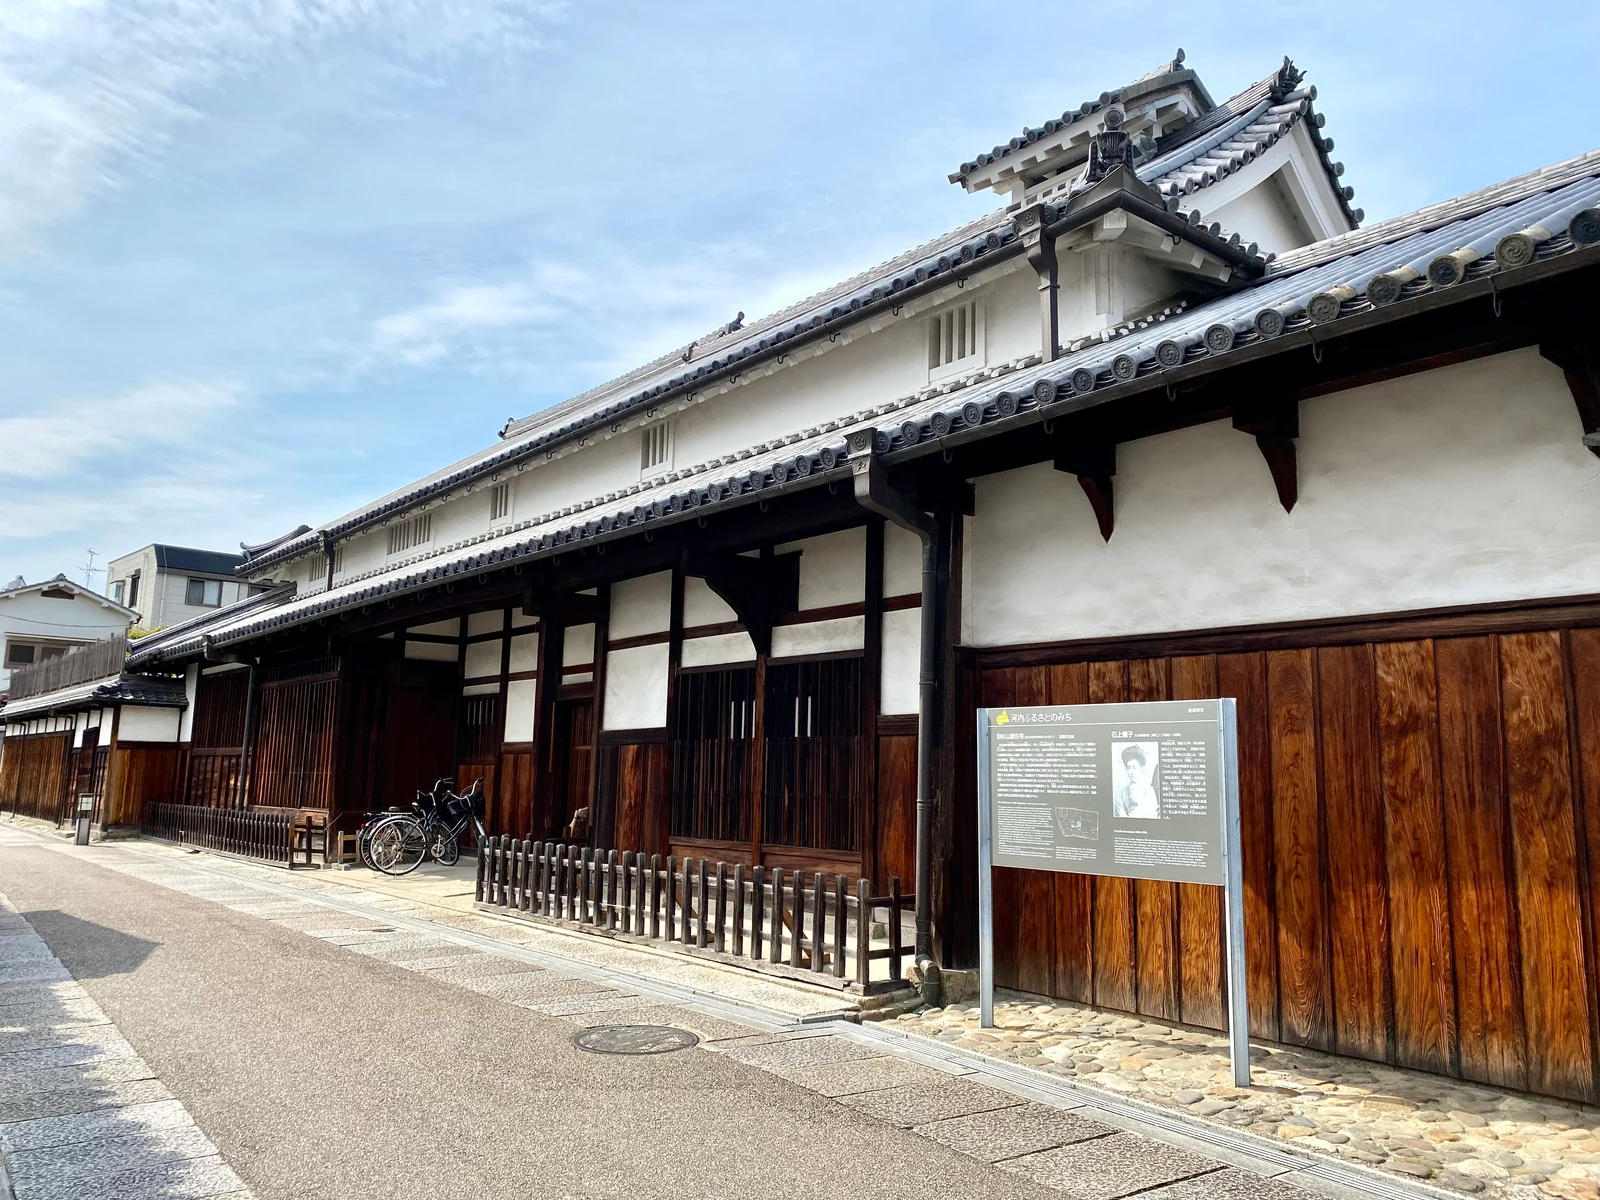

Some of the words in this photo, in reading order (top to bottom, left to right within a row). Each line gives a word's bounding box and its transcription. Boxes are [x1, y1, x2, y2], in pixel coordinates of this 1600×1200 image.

[1010, 712, 1072, 723] 河内ふるさとのみち
